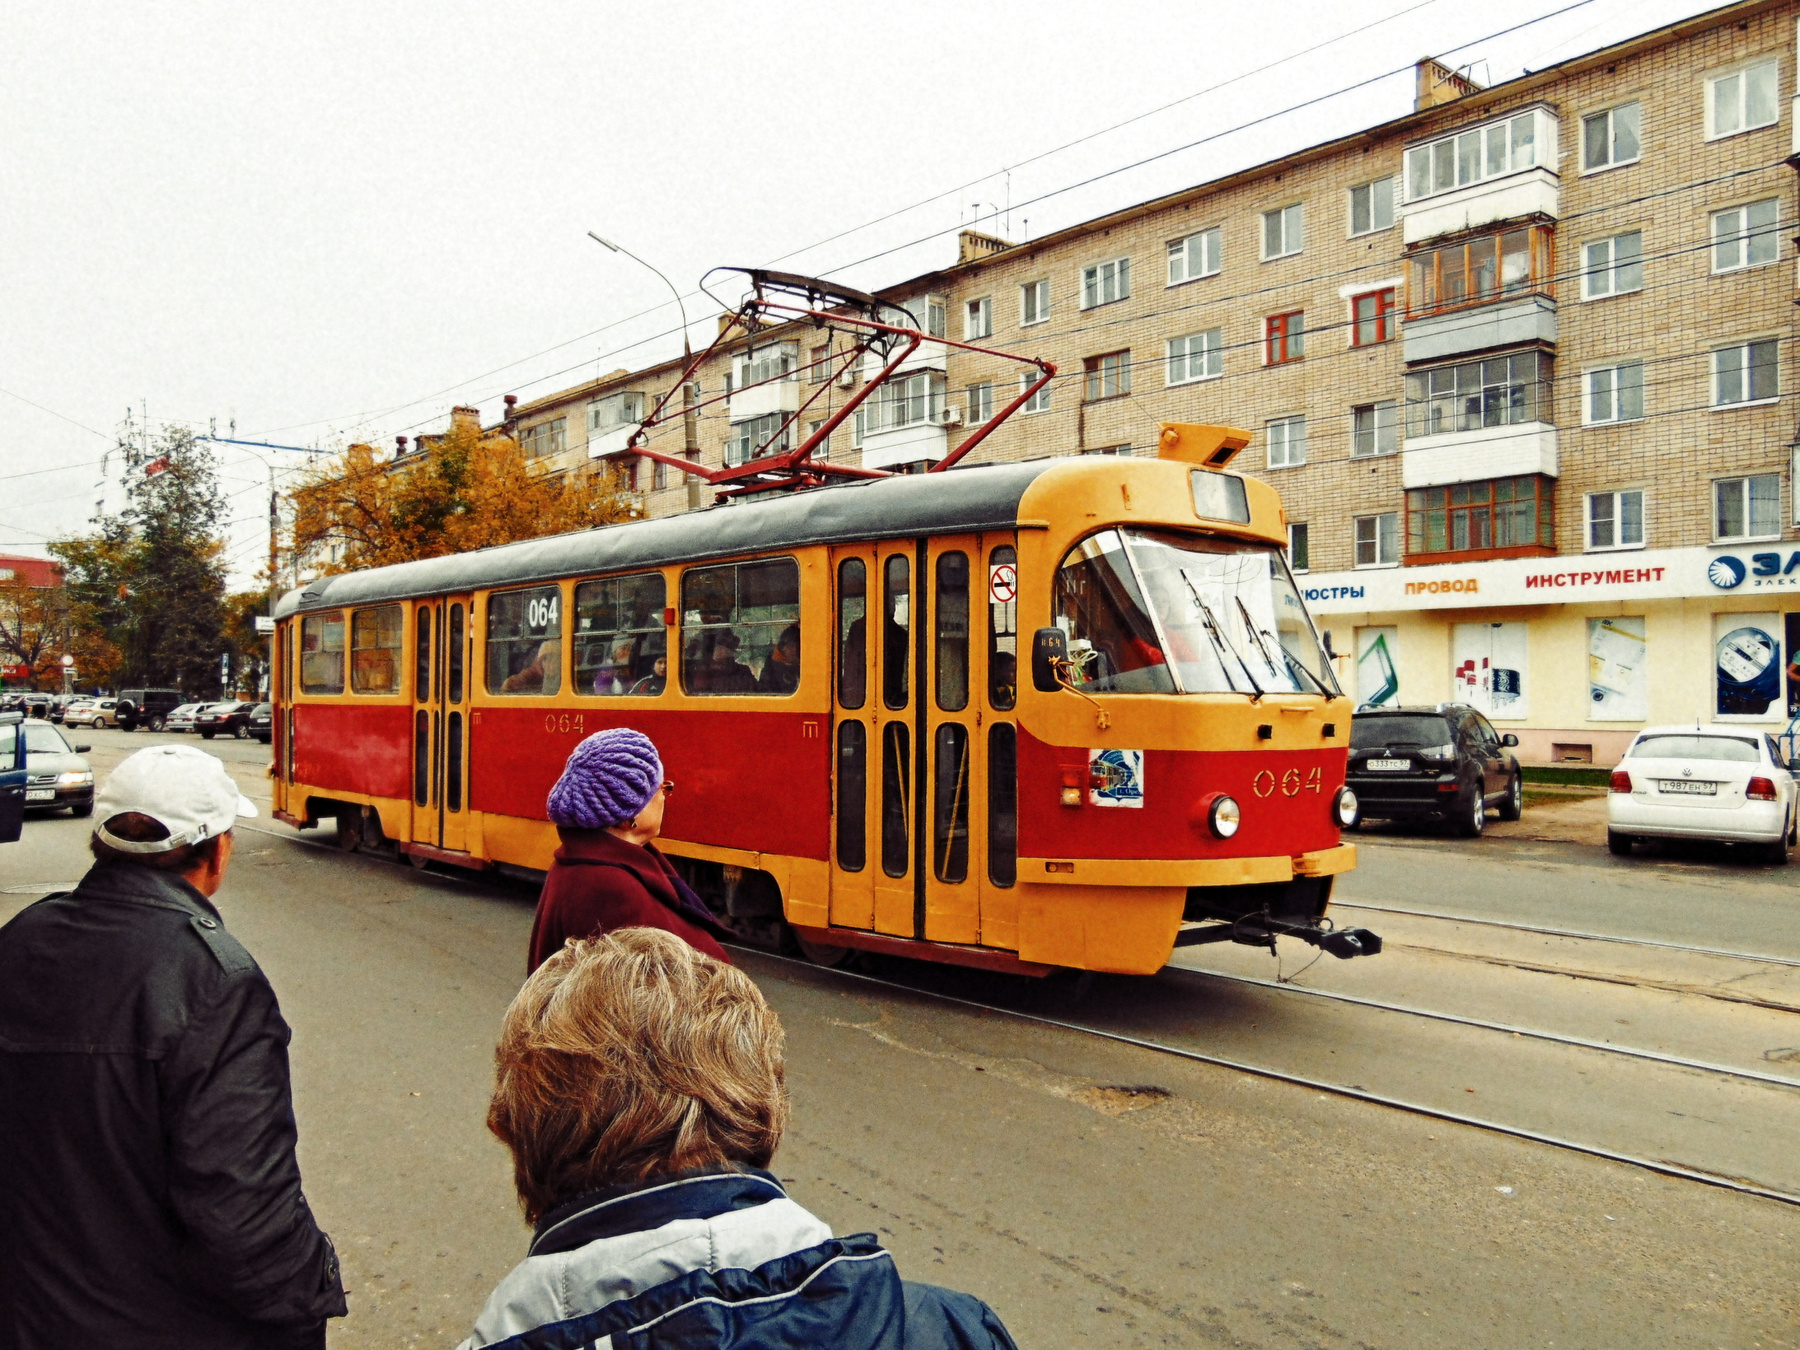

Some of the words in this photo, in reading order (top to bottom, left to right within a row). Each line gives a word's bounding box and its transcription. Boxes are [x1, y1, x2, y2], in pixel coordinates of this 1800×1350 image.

[1404, 578, 1478, 595] ПРОВОД
[1525, 567, 1665, 589] ИНСТРУМЕНТ
[1300, 586, 1365, 601] ЮСТРЫ
[528, 596, 558, 627] 064
[545, 714, 584, 734] 064
[1253, 767, 1321, 798] 064
